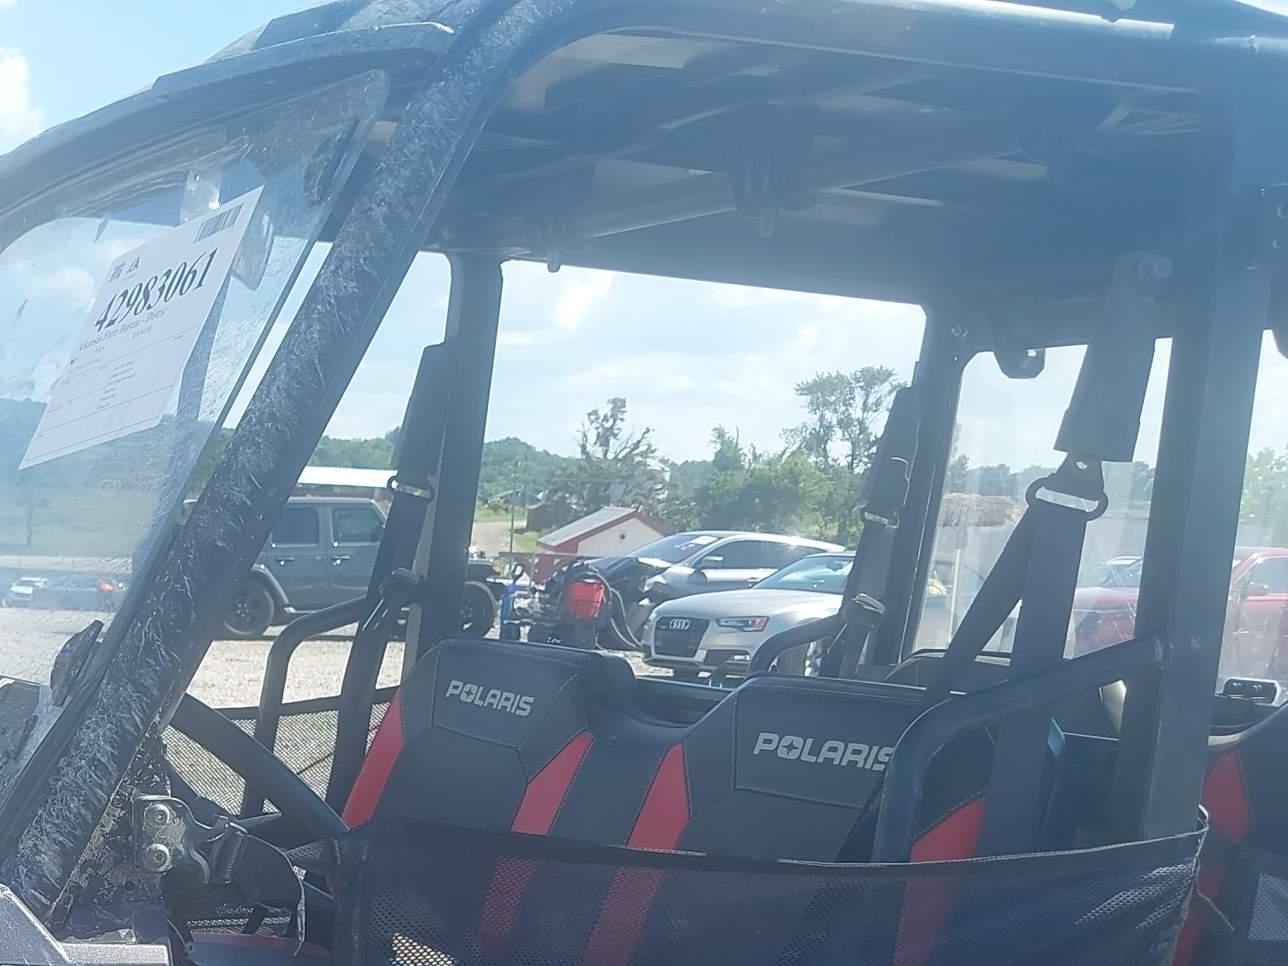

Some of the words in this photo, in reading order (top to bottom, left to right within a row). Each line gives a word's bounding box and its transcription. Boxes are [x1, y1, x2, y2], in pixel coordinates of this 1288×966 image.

[94, 247, 218, 333] 42983061
[444, 679, 535, 718] POLARIS
[753, 732, 896, 772] POLARIS
